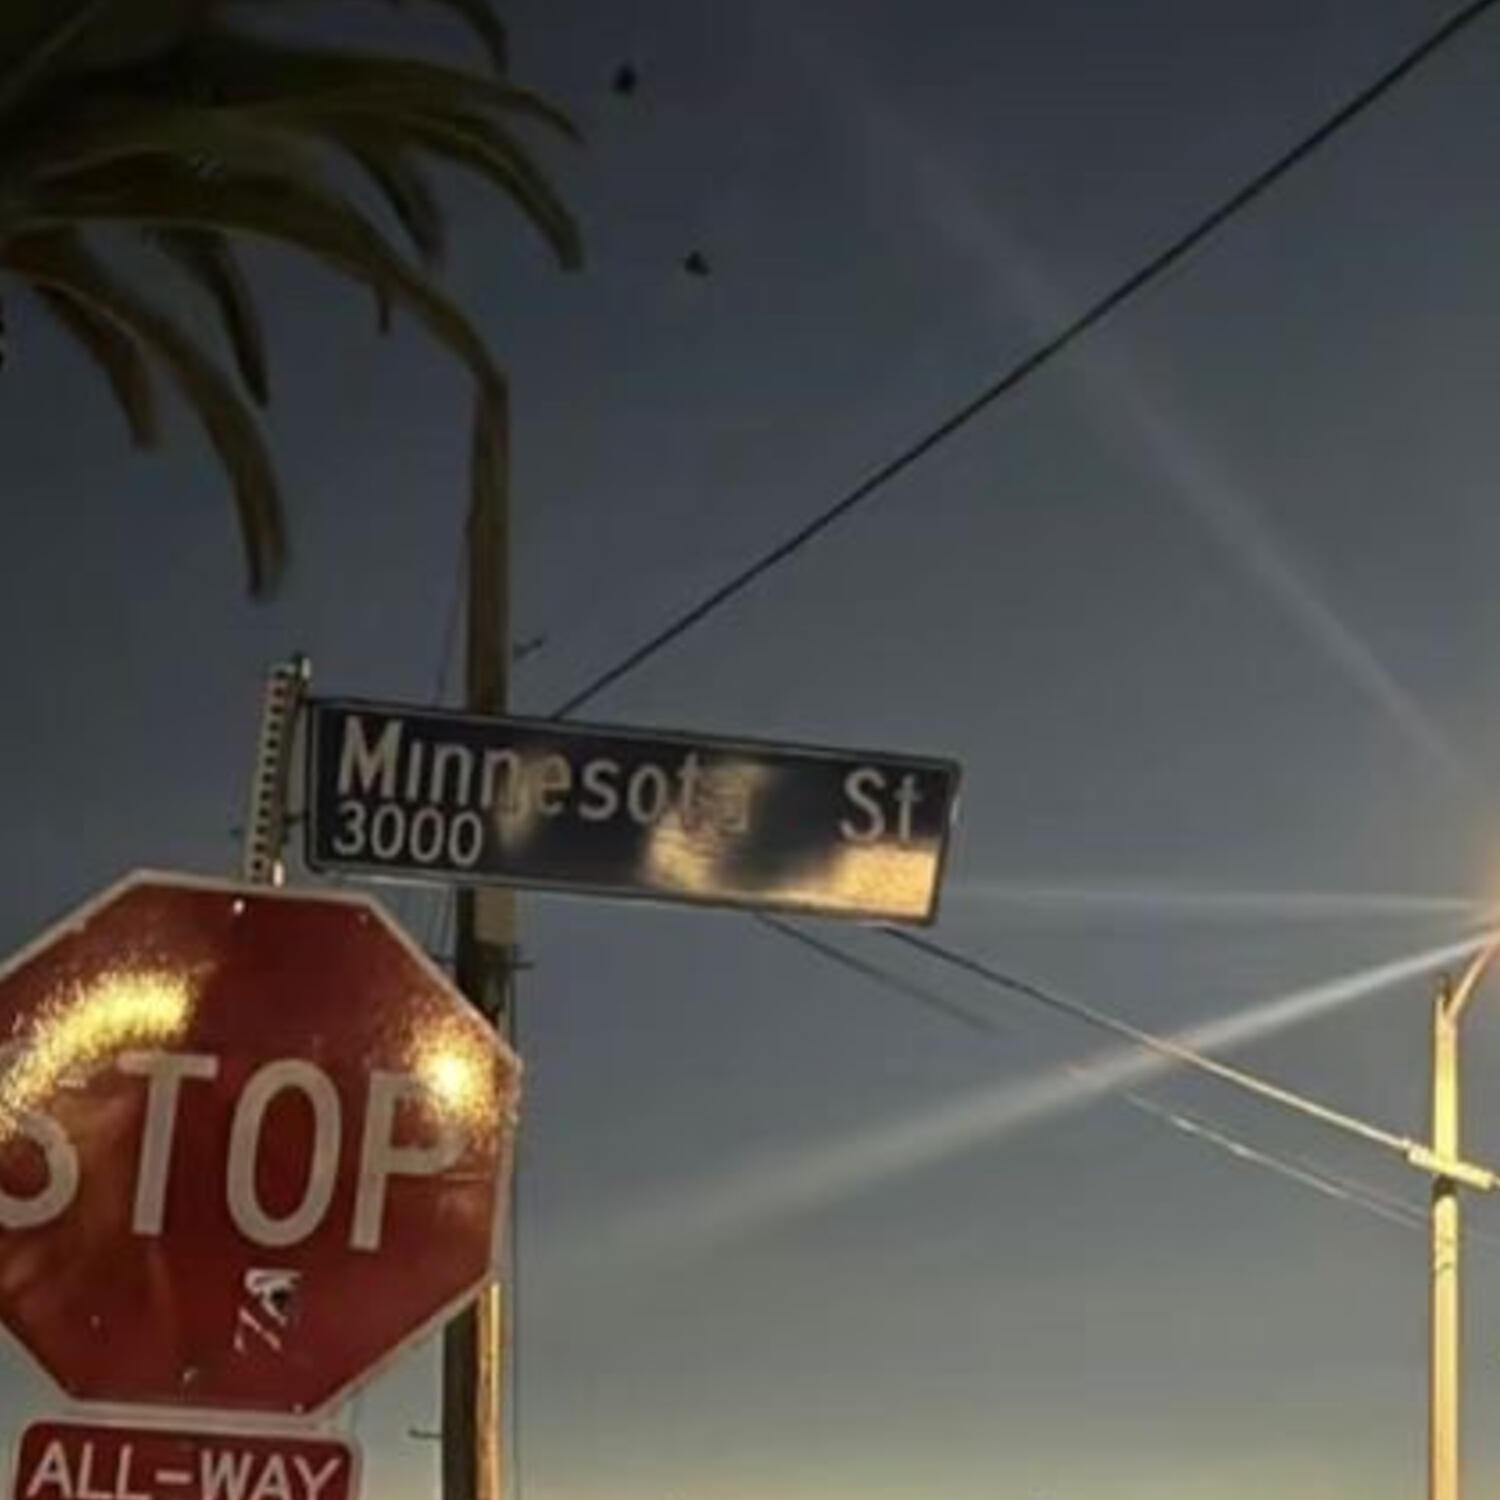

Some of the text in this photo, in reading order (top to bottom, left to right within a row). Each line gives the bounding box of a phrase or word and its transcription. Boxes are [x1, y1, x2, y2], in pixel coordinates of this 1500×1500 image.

[333, 803, 484, 865] 3000
[840, 770, 922, 841] St
[0, 1042, 474, 1252] STOP
